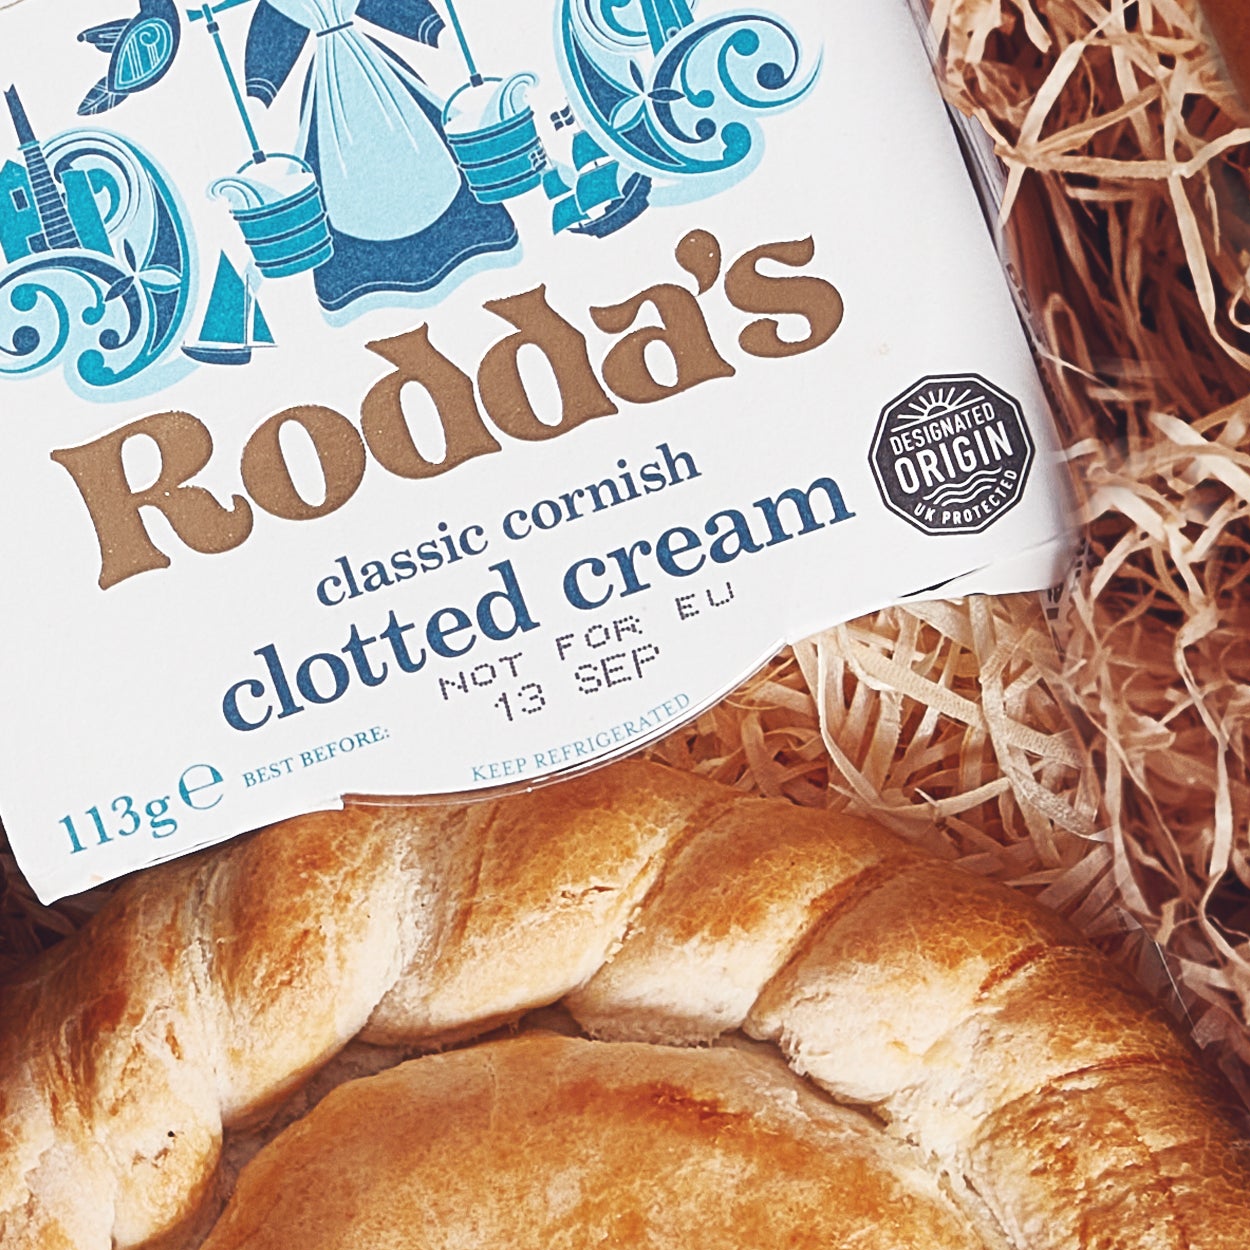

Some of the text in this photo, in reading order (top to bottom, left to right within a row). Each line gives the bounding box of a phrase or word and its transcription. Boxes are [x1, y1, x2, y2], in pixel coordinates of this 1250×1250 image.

[52, 231, 843, 589] Rodda's
[890, 403, 994, 455] DESIGNATED
[895, 421, 1013, 494] ORIGIN
[915, 471, 1017, 524] UK PROTECTED
[317, 446, 701, 606] classic cornish
[223, 478, 855, 731] clotted cream
[439, 582, 734, 700] NOT FOR EU
[495, 644, 659, 721] 13 SEP
[243, 727, 389, 787] BEST BEFORE:
[472, 694, 689, 781] KEEP REFRIGERATED
